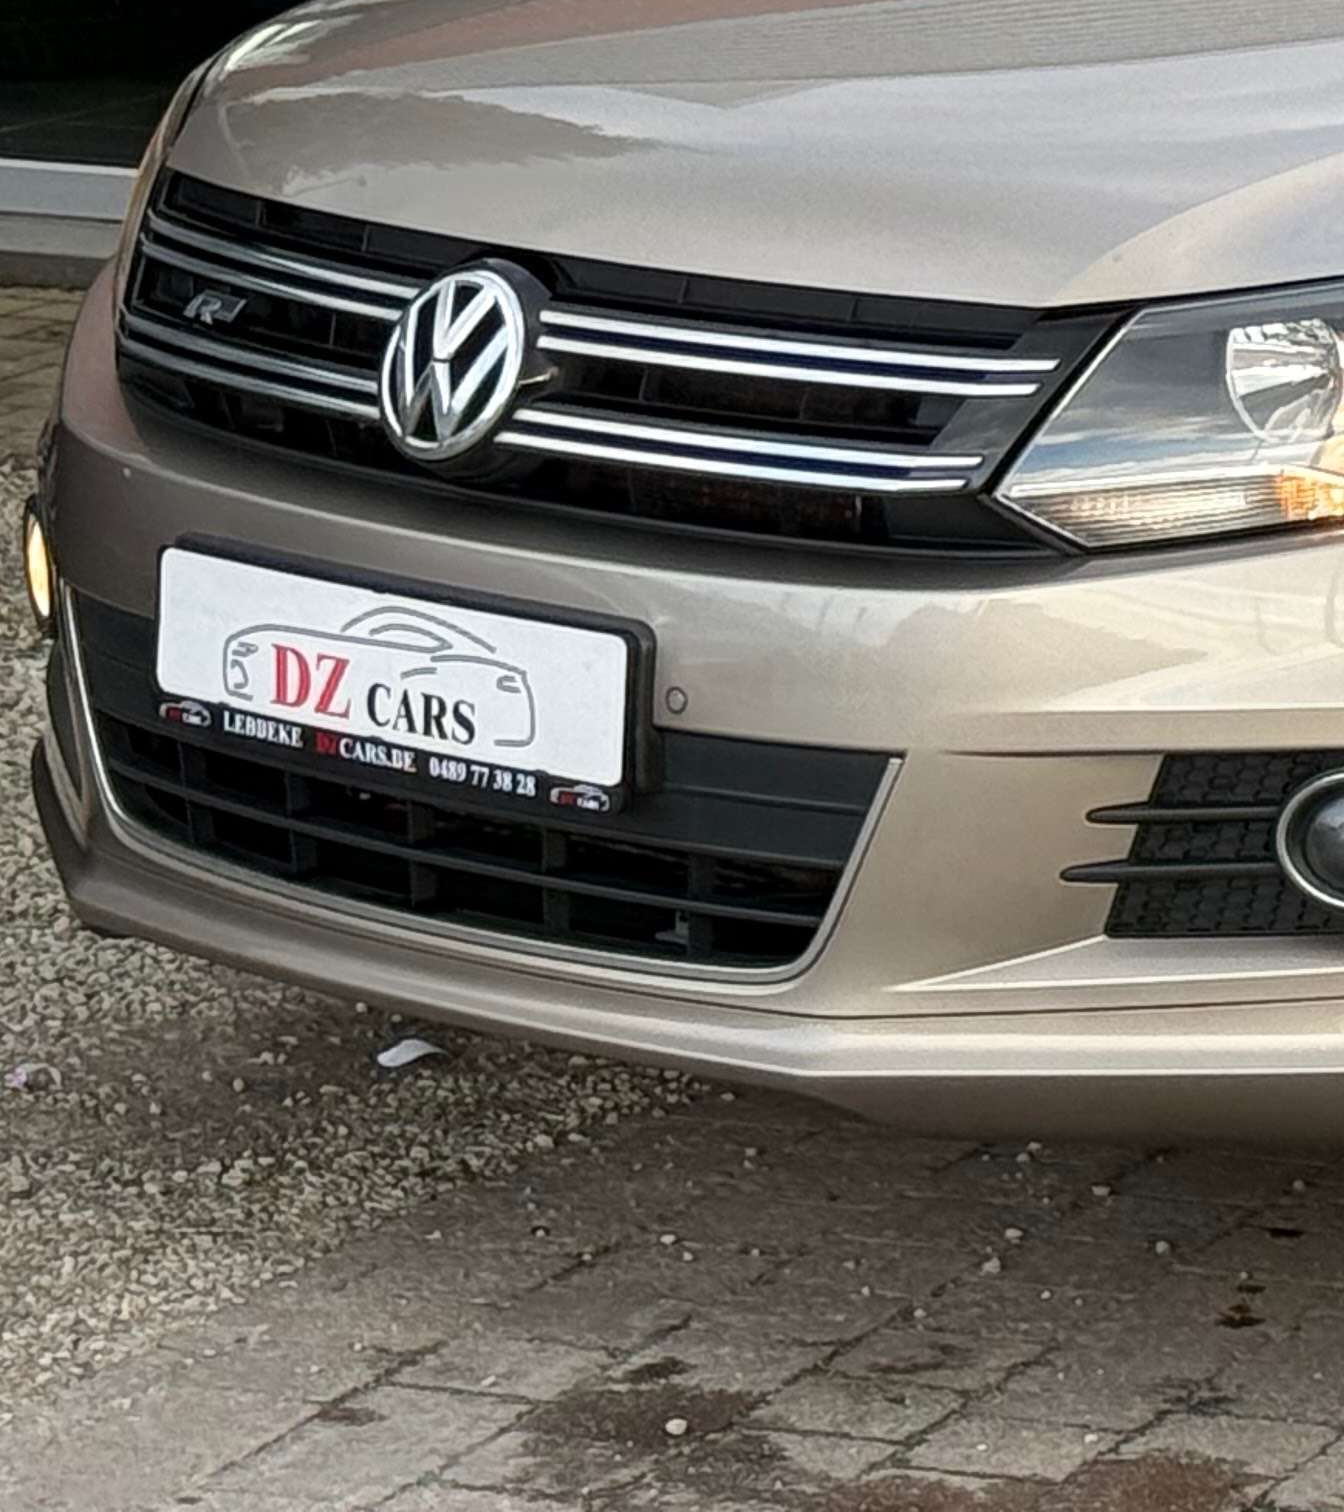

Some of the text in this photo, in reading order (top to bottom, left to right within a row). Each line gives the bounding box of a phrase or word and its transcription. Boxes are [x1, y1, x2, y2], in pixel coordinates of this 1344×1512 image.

[270, 643, 476, 746] DZ CARS
[429, 755, 467, 783] 0489
[470, 764, 491, 789] 77
[493, 769, 514, 793] 38
[515, 774, 538, 798] 28
